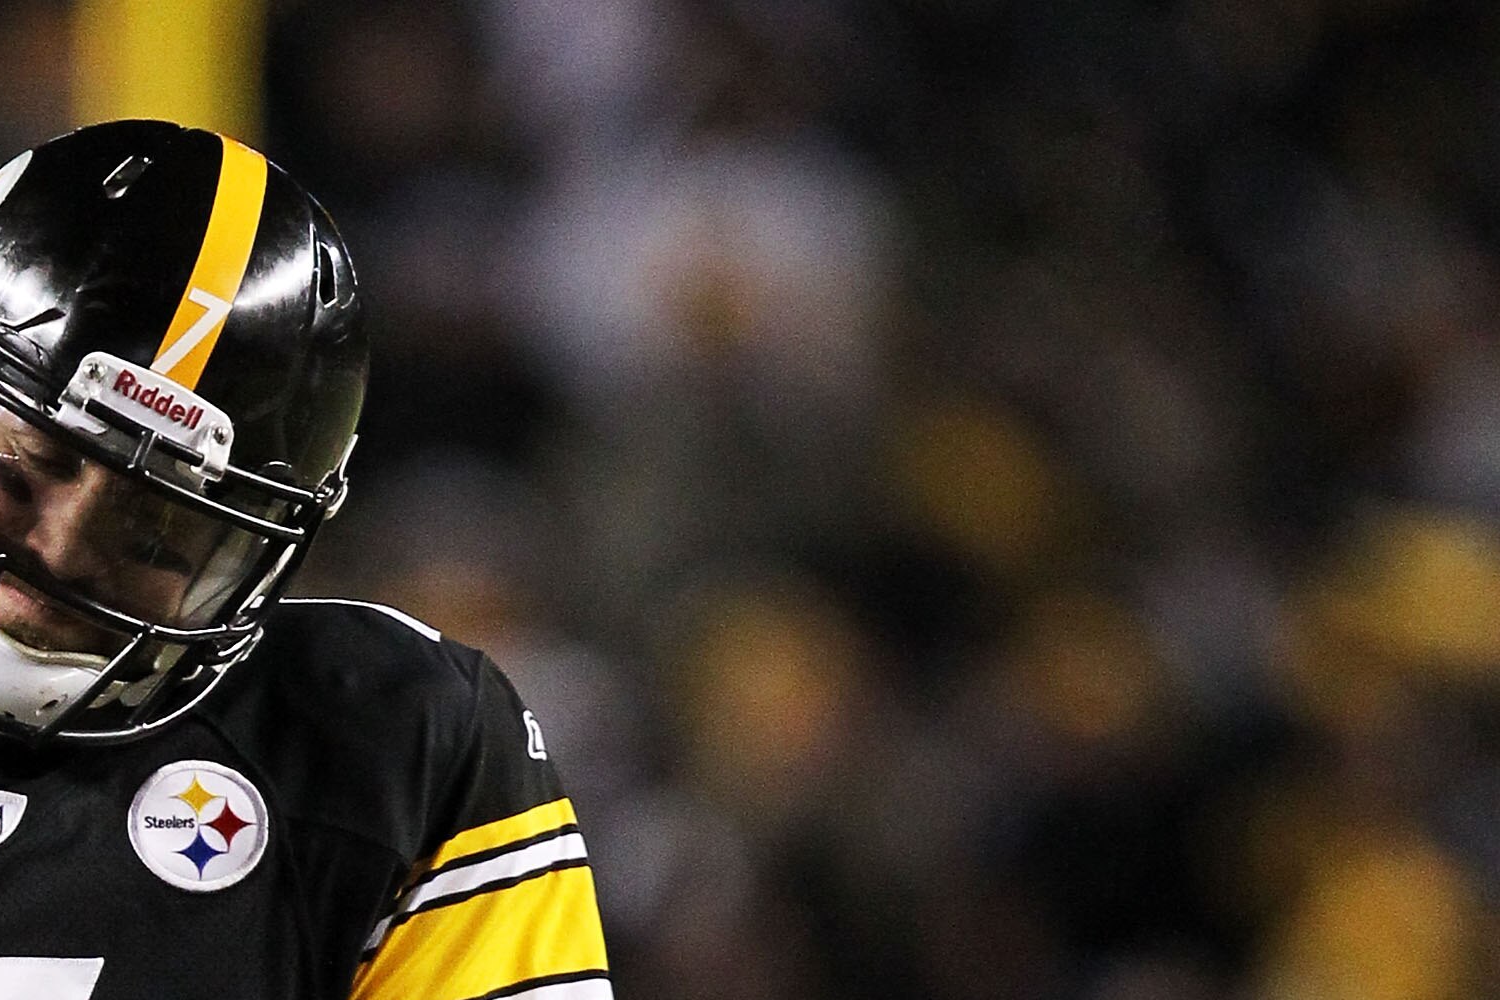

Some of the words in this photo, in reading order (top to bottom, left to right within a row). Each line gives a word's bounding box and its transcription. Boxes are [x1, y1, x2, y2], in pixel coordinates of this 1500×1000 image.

[149, 287, 233, 375] 7
[112, 368, 204, 430] Riddell
[144, 815, 196, 829] Steelers
